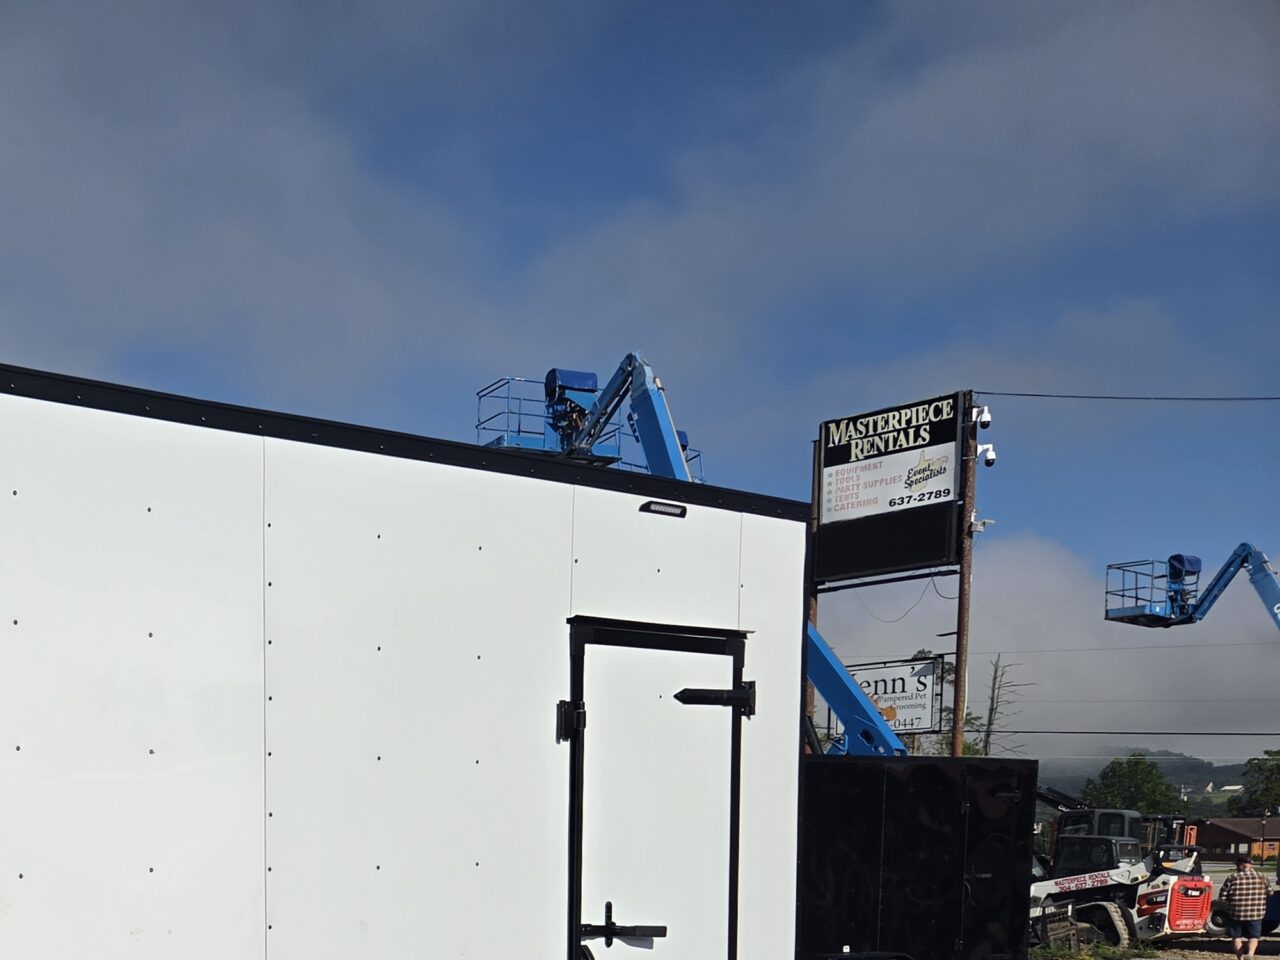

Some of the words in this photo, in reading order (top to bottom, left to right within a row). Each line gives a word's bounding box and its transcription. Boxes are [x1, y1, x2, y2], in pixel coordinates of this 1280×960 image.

[827, 399, 954, 448] MASTERPIECE
[849, 425, 931, 462] RENTALS
[835, 461, 883, 477] EQUIPMENT
[904, 466, 947, 489] Specialists
[907, 463, 931, 479] Event
[835, 474, 861, 486] TOOLS
[835, 483, 861, 494] PARTY
[863, 475, 903, 489] SUPPLIES
[833, 497, 879, 512] CATERING
[834, 492, 860, 503] TENTS
[888, 488, 951, 508] 637-2789
[851, 666, 927, 695] enn's
[915, 692, 927, 700] Pet
